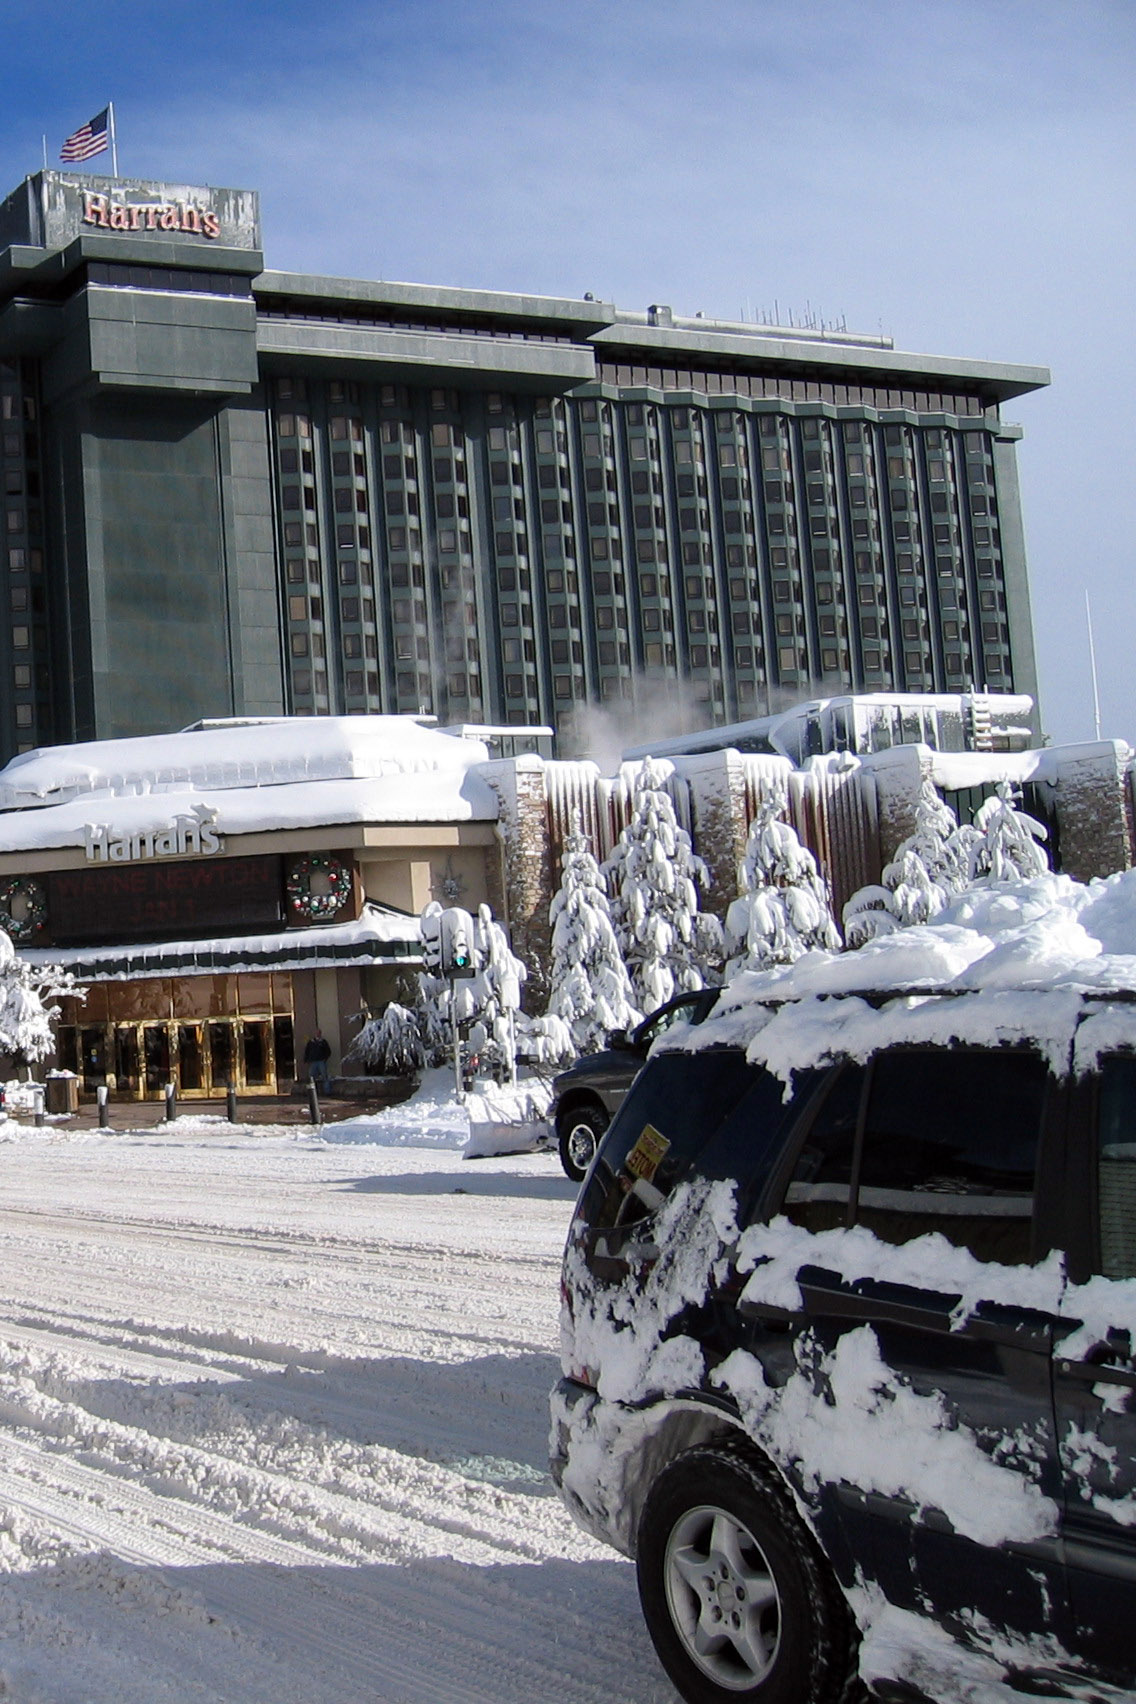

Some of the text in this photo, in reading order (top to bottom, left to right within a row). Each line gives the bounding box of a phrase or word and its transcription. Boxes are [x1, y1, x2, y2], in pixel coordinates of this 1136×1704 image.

[82, 190, 221, 238] Harrah's
[84, 812, 220, 862] Harrah's
[57, 861, 270, 897] WAYNE NEWTON
[133, 900, 177, 924] JAN
